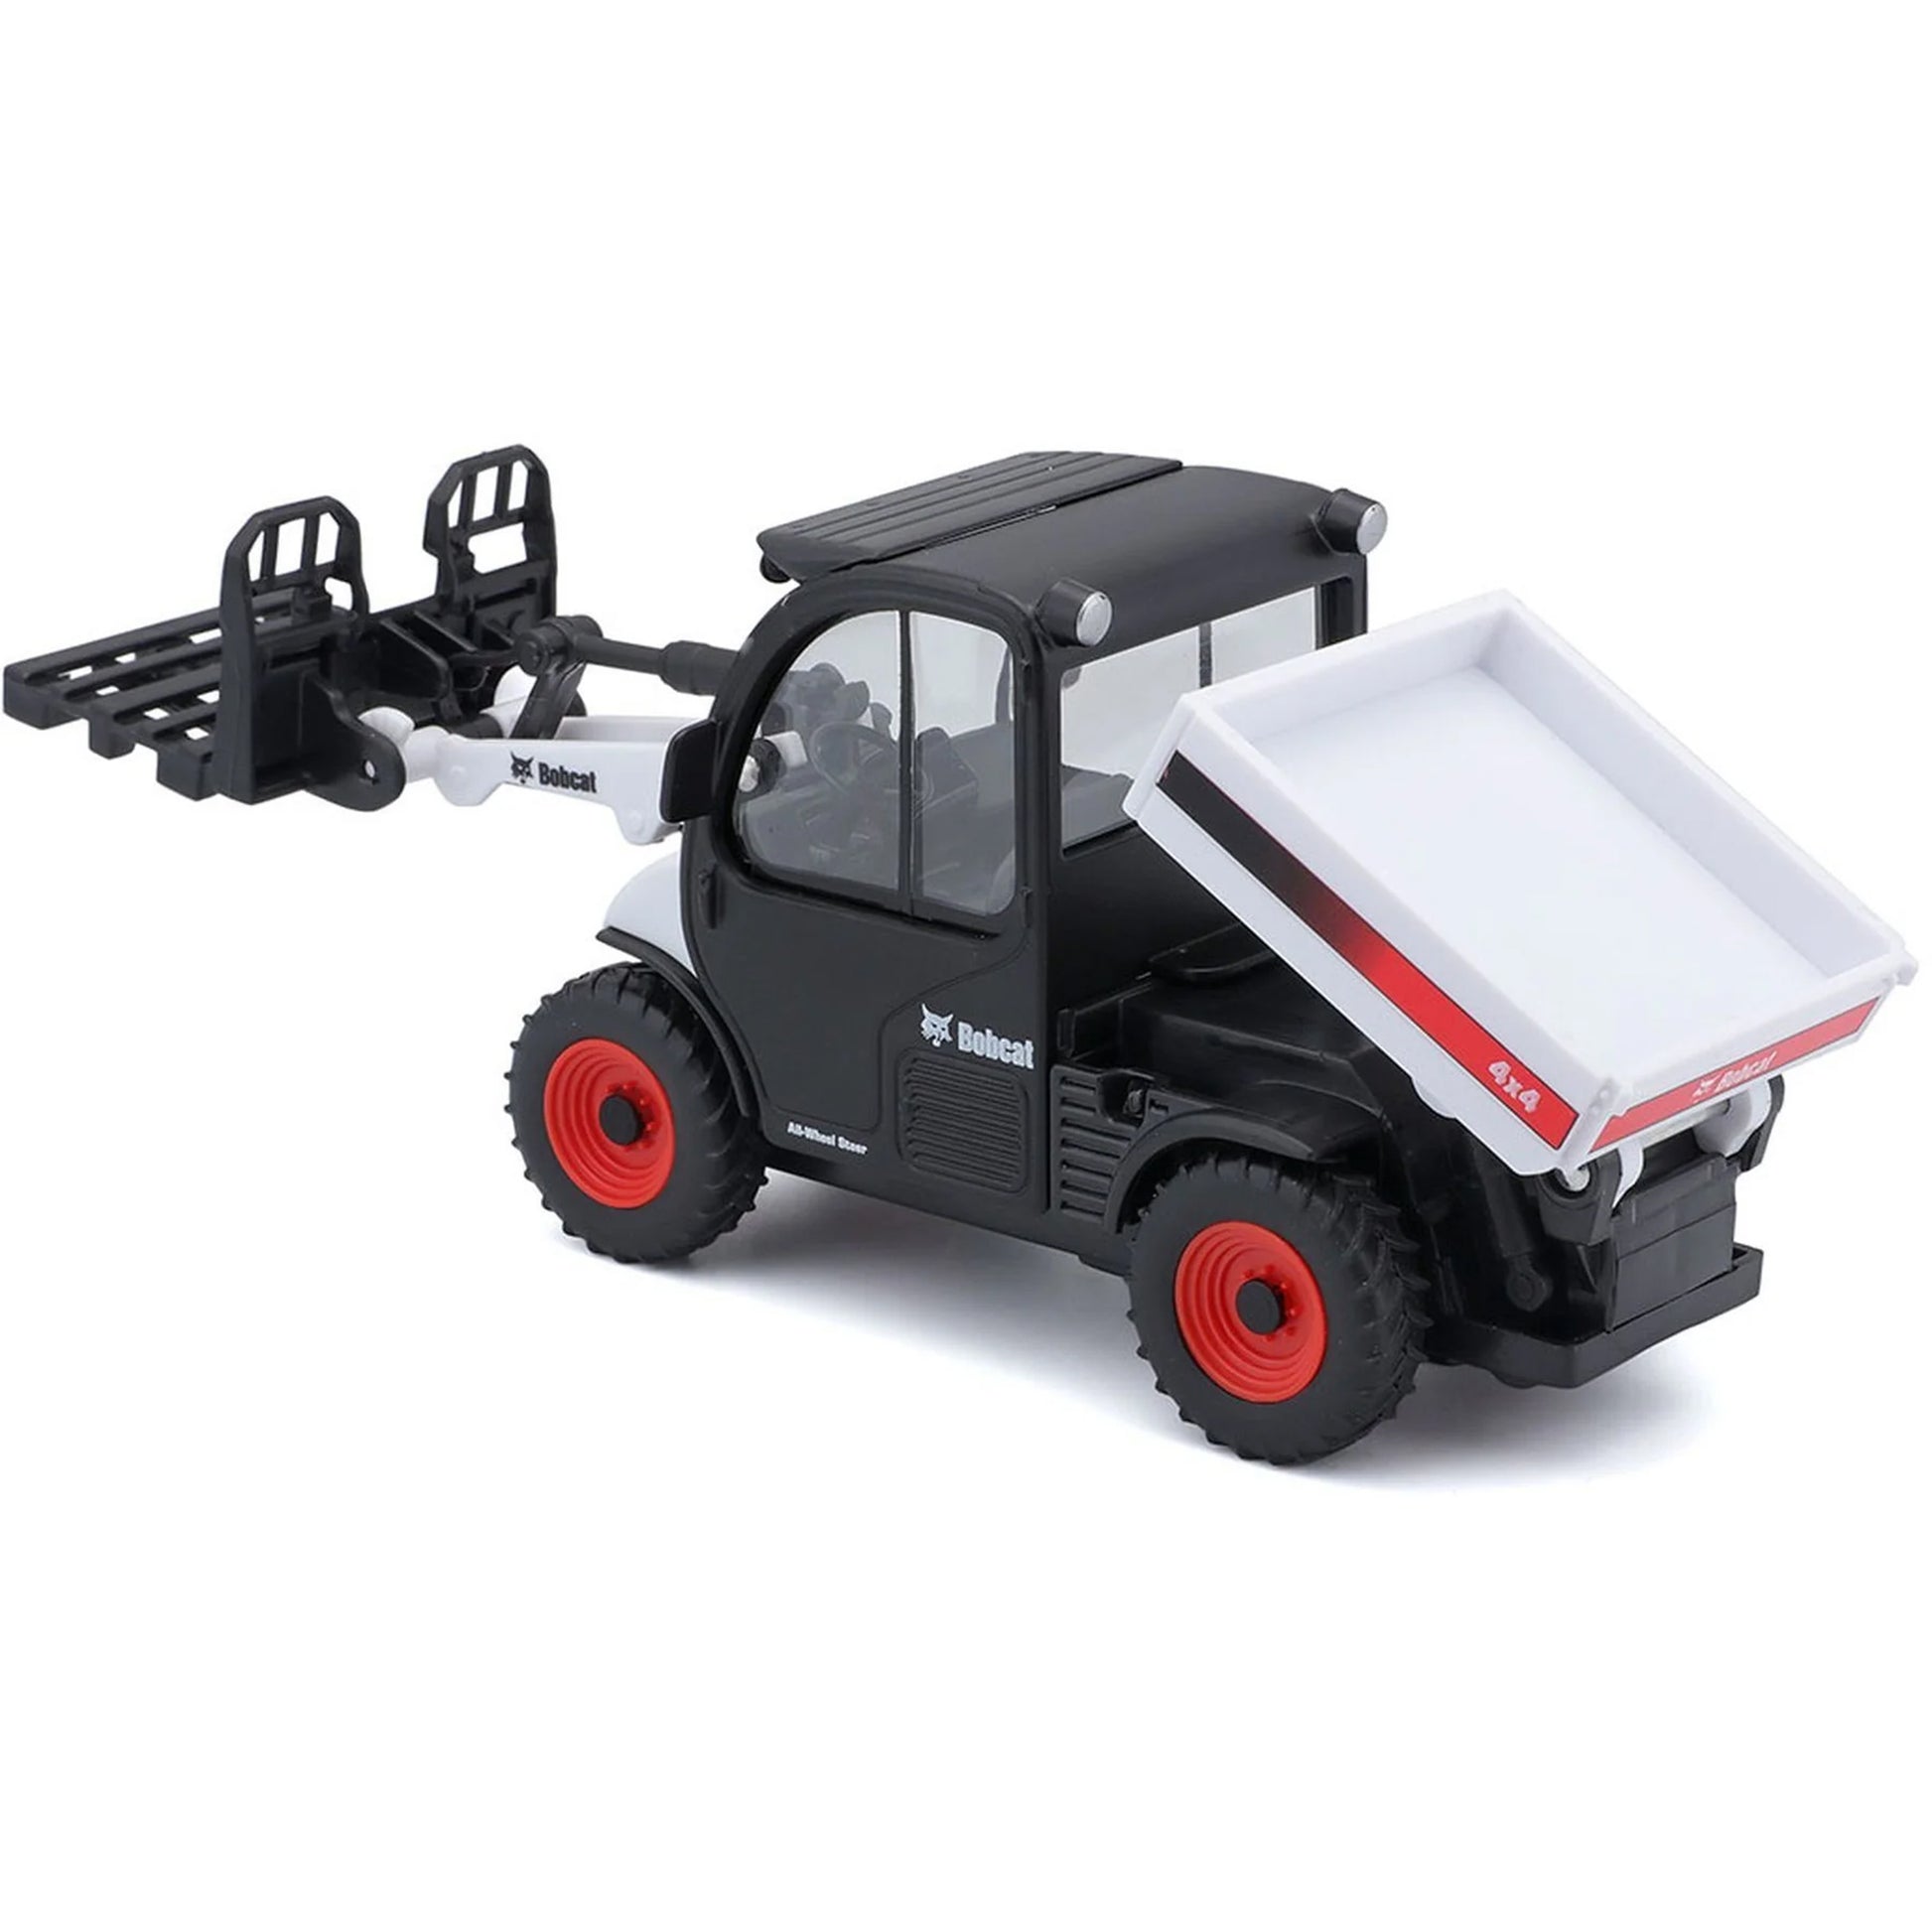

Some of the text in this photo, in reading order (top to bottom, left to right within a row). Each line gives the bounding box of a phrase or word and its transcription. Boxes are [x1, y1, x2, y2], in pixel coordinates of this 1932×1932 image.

[538, 761, 598, 793] Bobcat
[958, 1021, 1034, 1069] Bobcat
[1488, 1060, 1541, 1113] 4x4
[787, 1121, 868, 1155] All-Wheel Steer
